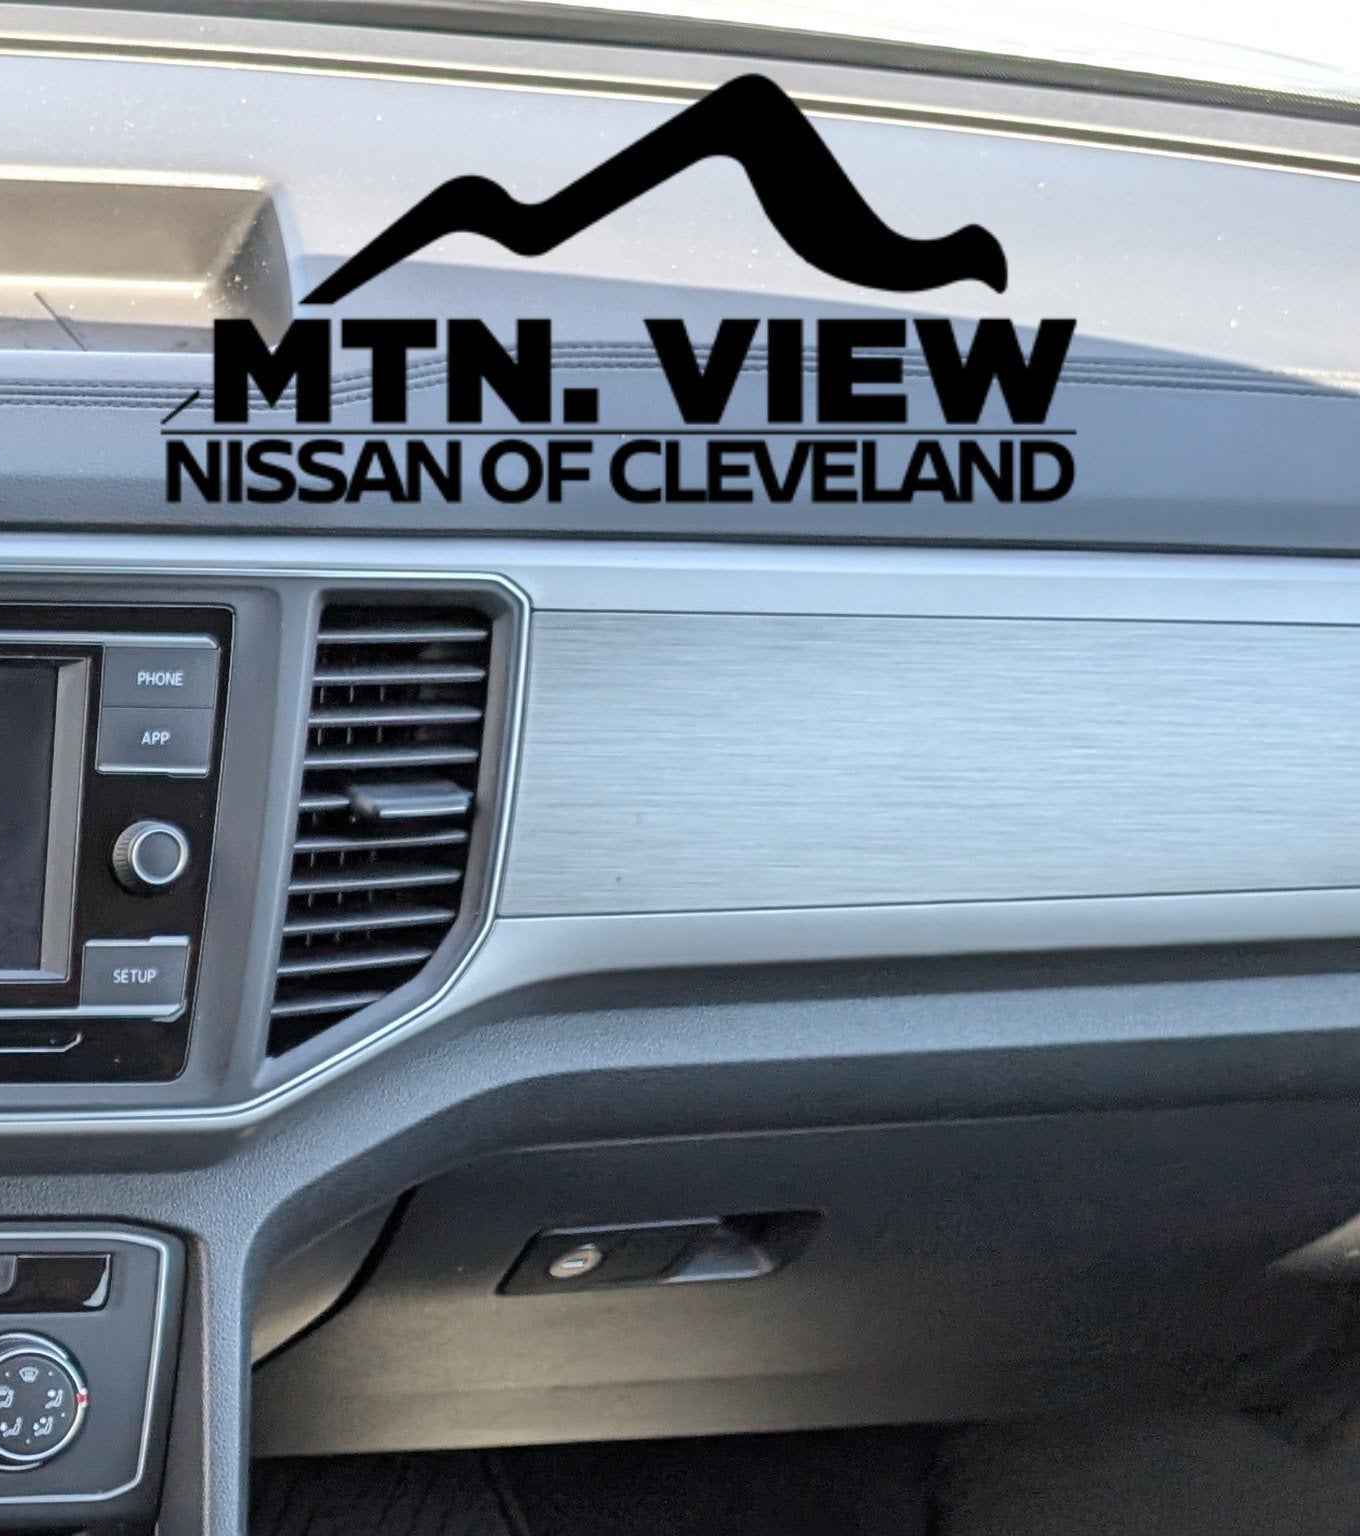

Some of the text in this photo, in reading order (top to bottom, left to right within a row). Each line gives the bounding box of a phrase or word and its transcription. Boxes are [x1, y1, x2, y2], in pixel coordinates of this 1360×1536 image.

[136, 670, 185, 687] PHONE
[141, 731, 171, 746] APP
[112, 968, 158, 984] SETUP
